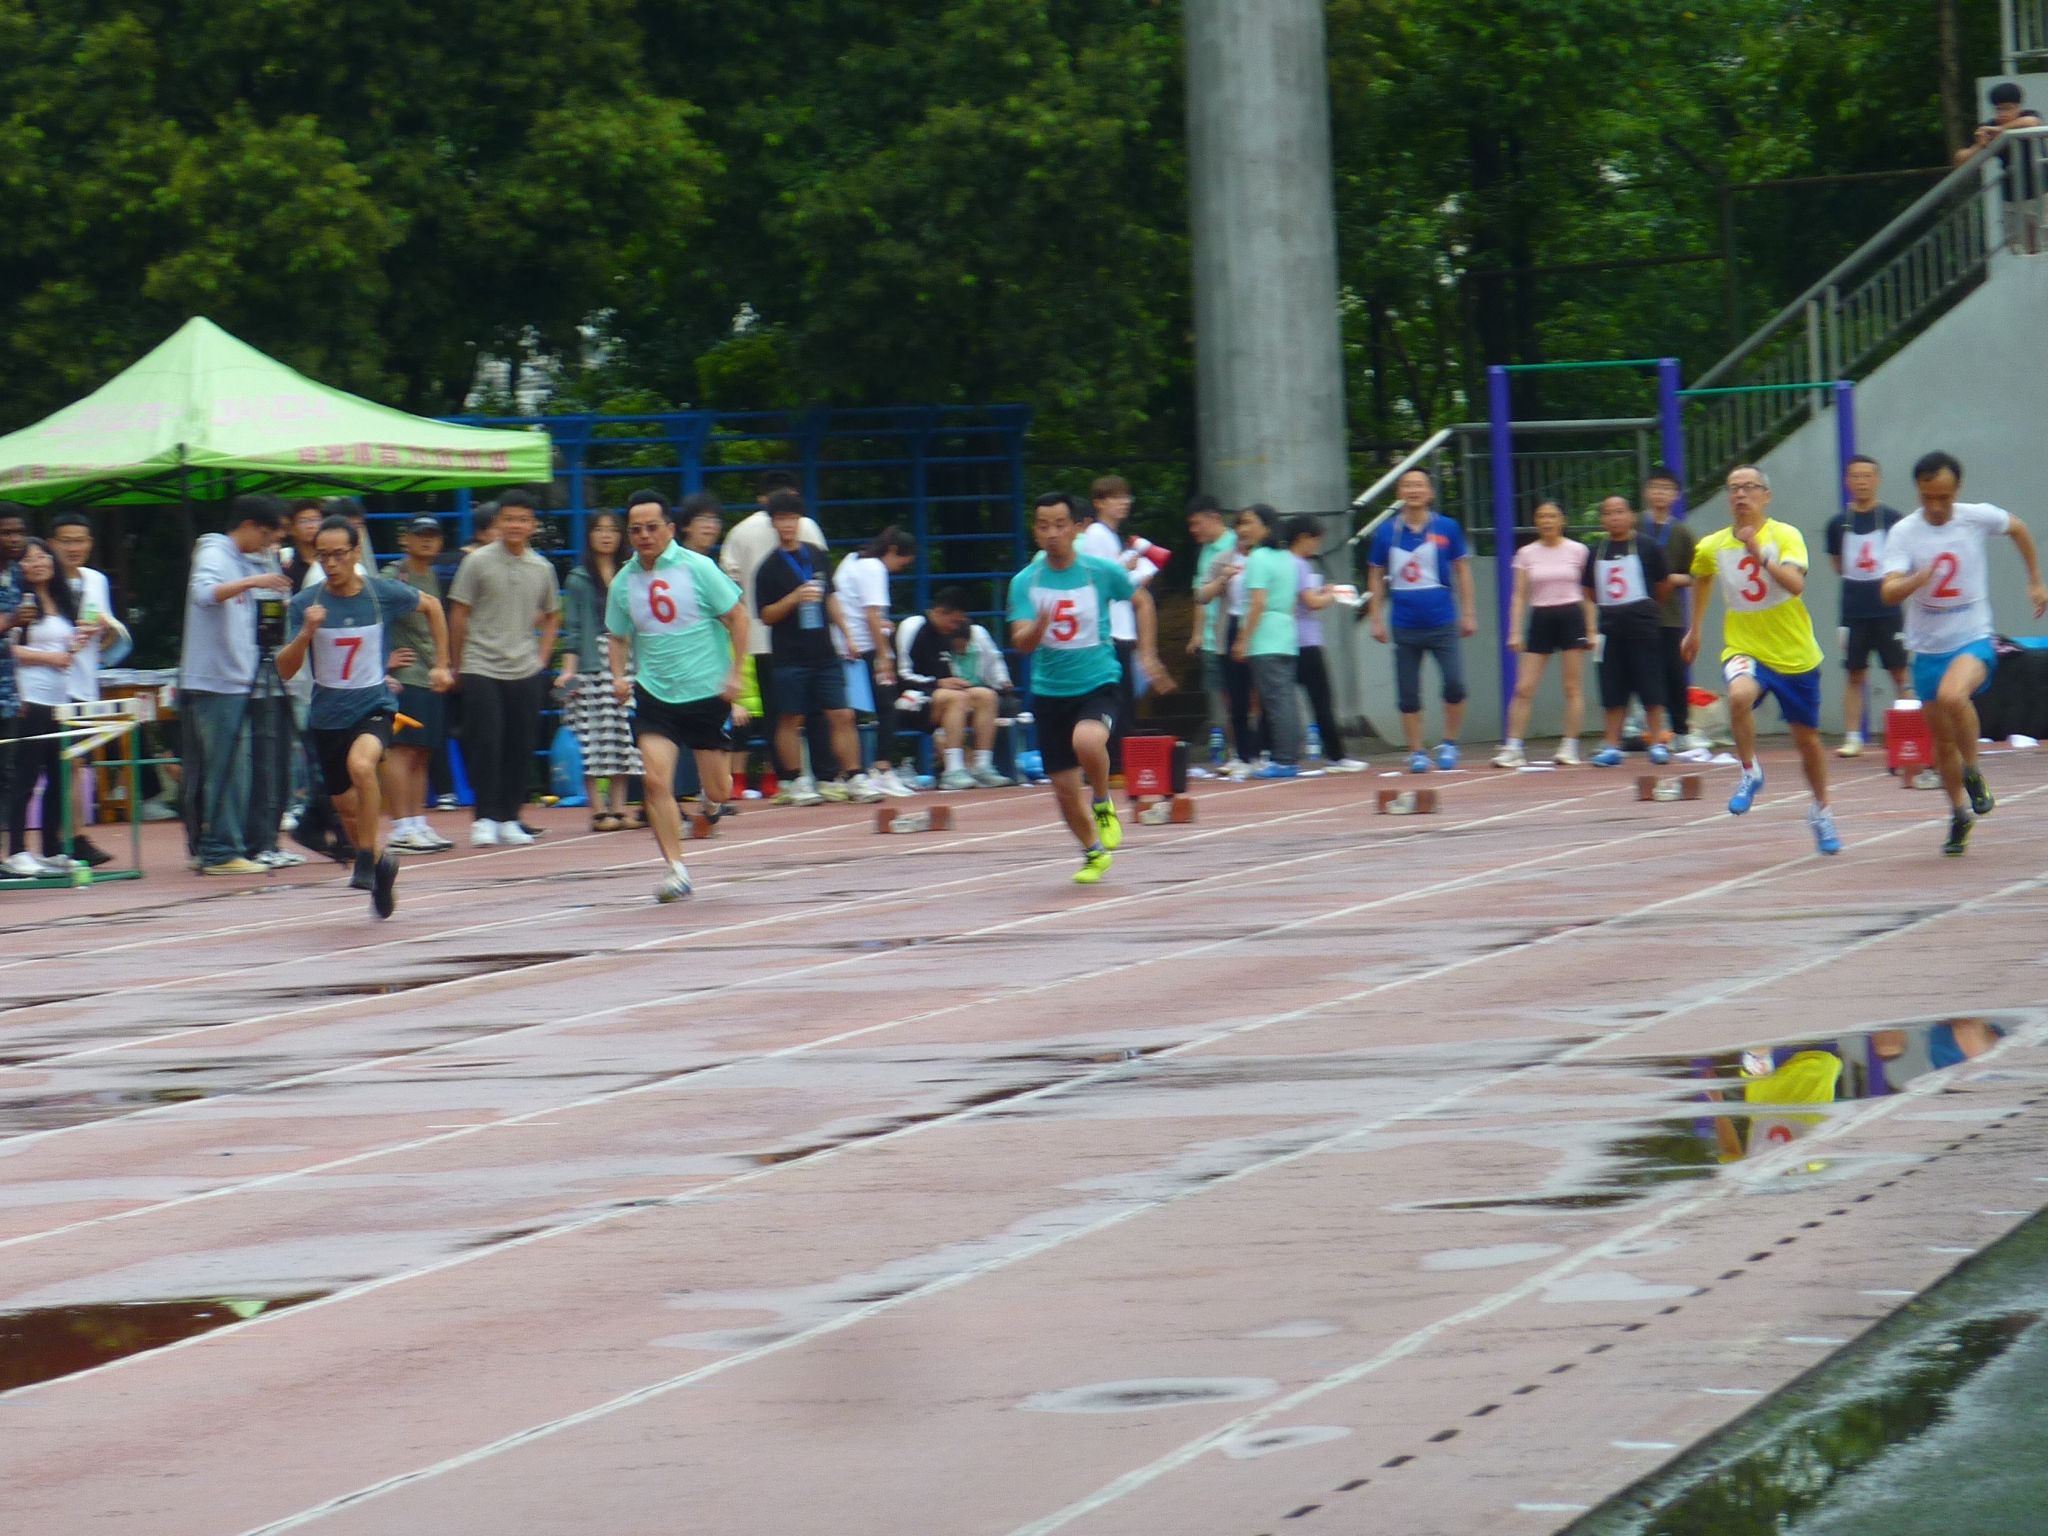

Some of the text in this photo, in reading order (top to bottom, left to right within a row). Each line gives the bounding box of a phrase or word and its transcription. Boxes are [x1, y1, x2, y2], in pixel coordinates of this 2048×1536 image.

[1738, 555, 1767, 602] 3
[1856, 541, 1878, 575] 4
[1930, 552, 1962, 598] 2
[650, 580, 677, 623] 6
[1607, 566, 1629, 600] 5
[1052, 600, 1080, 642] 5
[334, 638, 362, 679] 7
